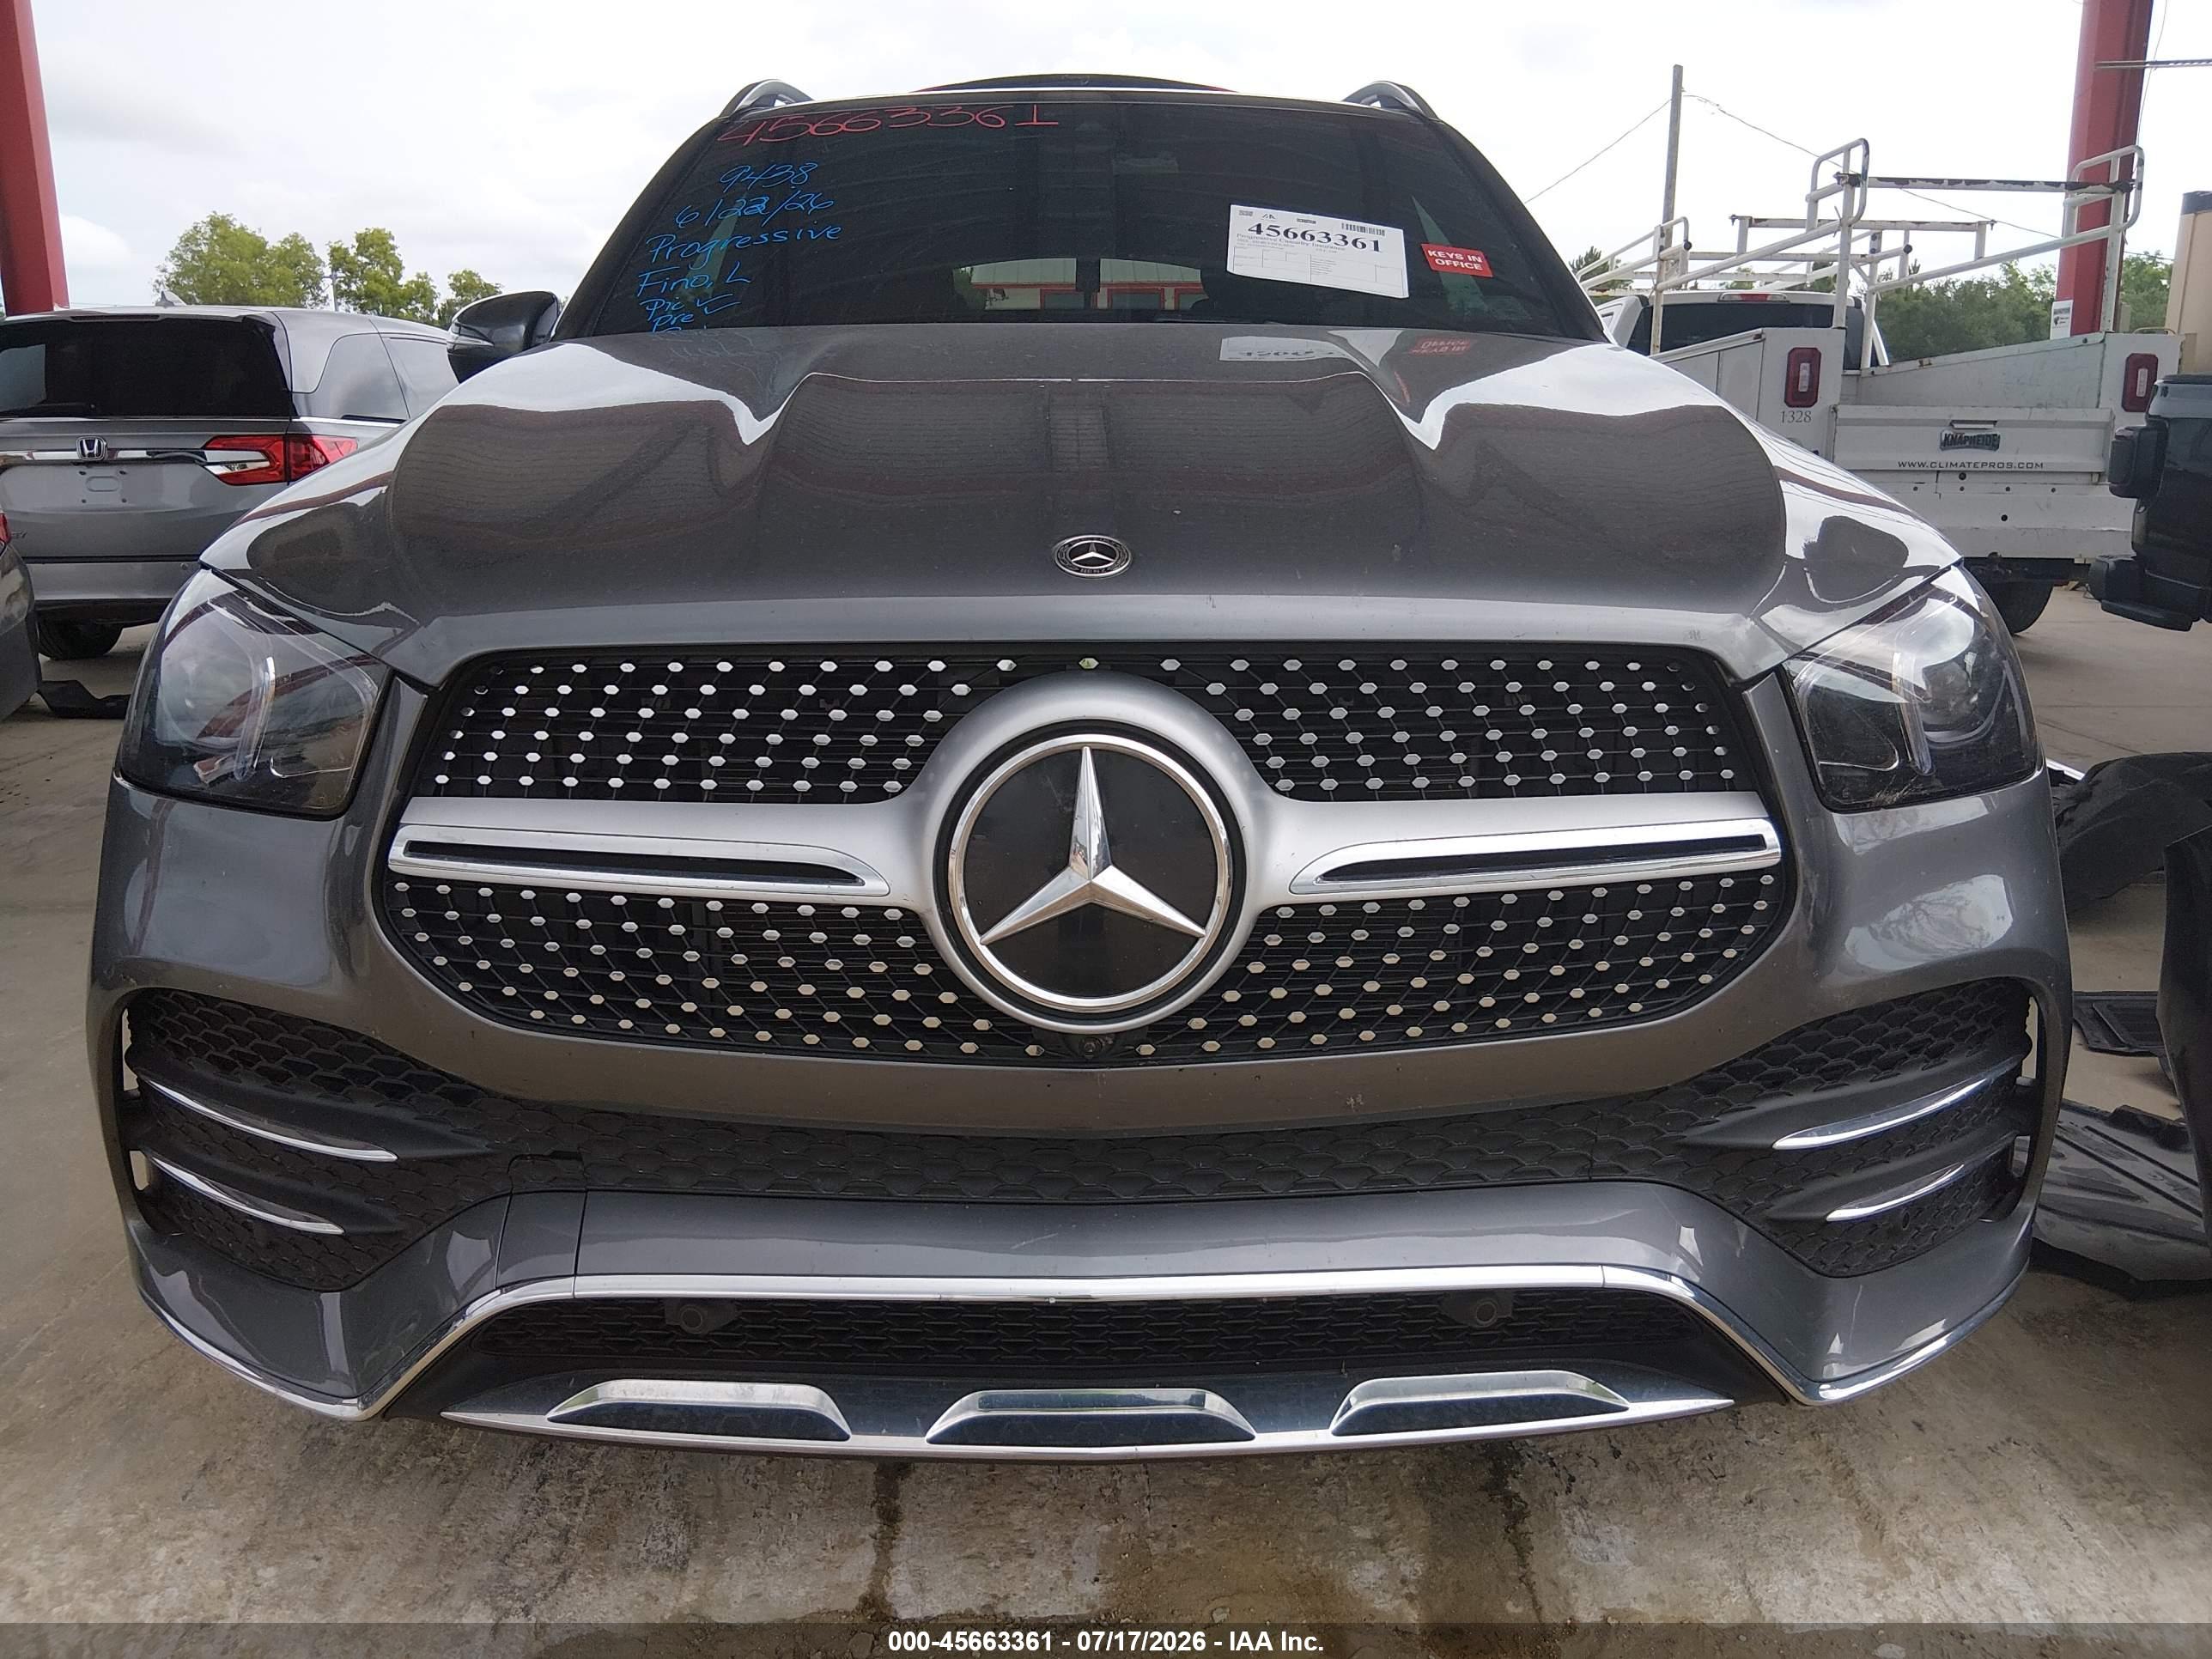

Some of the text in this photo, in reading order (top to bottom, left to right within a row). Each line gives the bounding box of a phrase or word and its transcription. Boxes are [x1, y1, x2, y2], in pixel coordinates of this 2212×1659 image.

[717, 103, 1059, 147] 45663361
[720, 161, 818, 193] 9438
[646, 225, 842, 270] Progressive
[1248, 222, 1382, 253] 45663361
[1427, 249, 1483, 263] KEYS IN
[1434, 258, 1484, 271] OFFICE
[725, 260, 752, 284] L
[1779, 410, 1812, 424] 1328
[1897, 459, 2044, 470] WWW.CLIMATEPROS.COM
